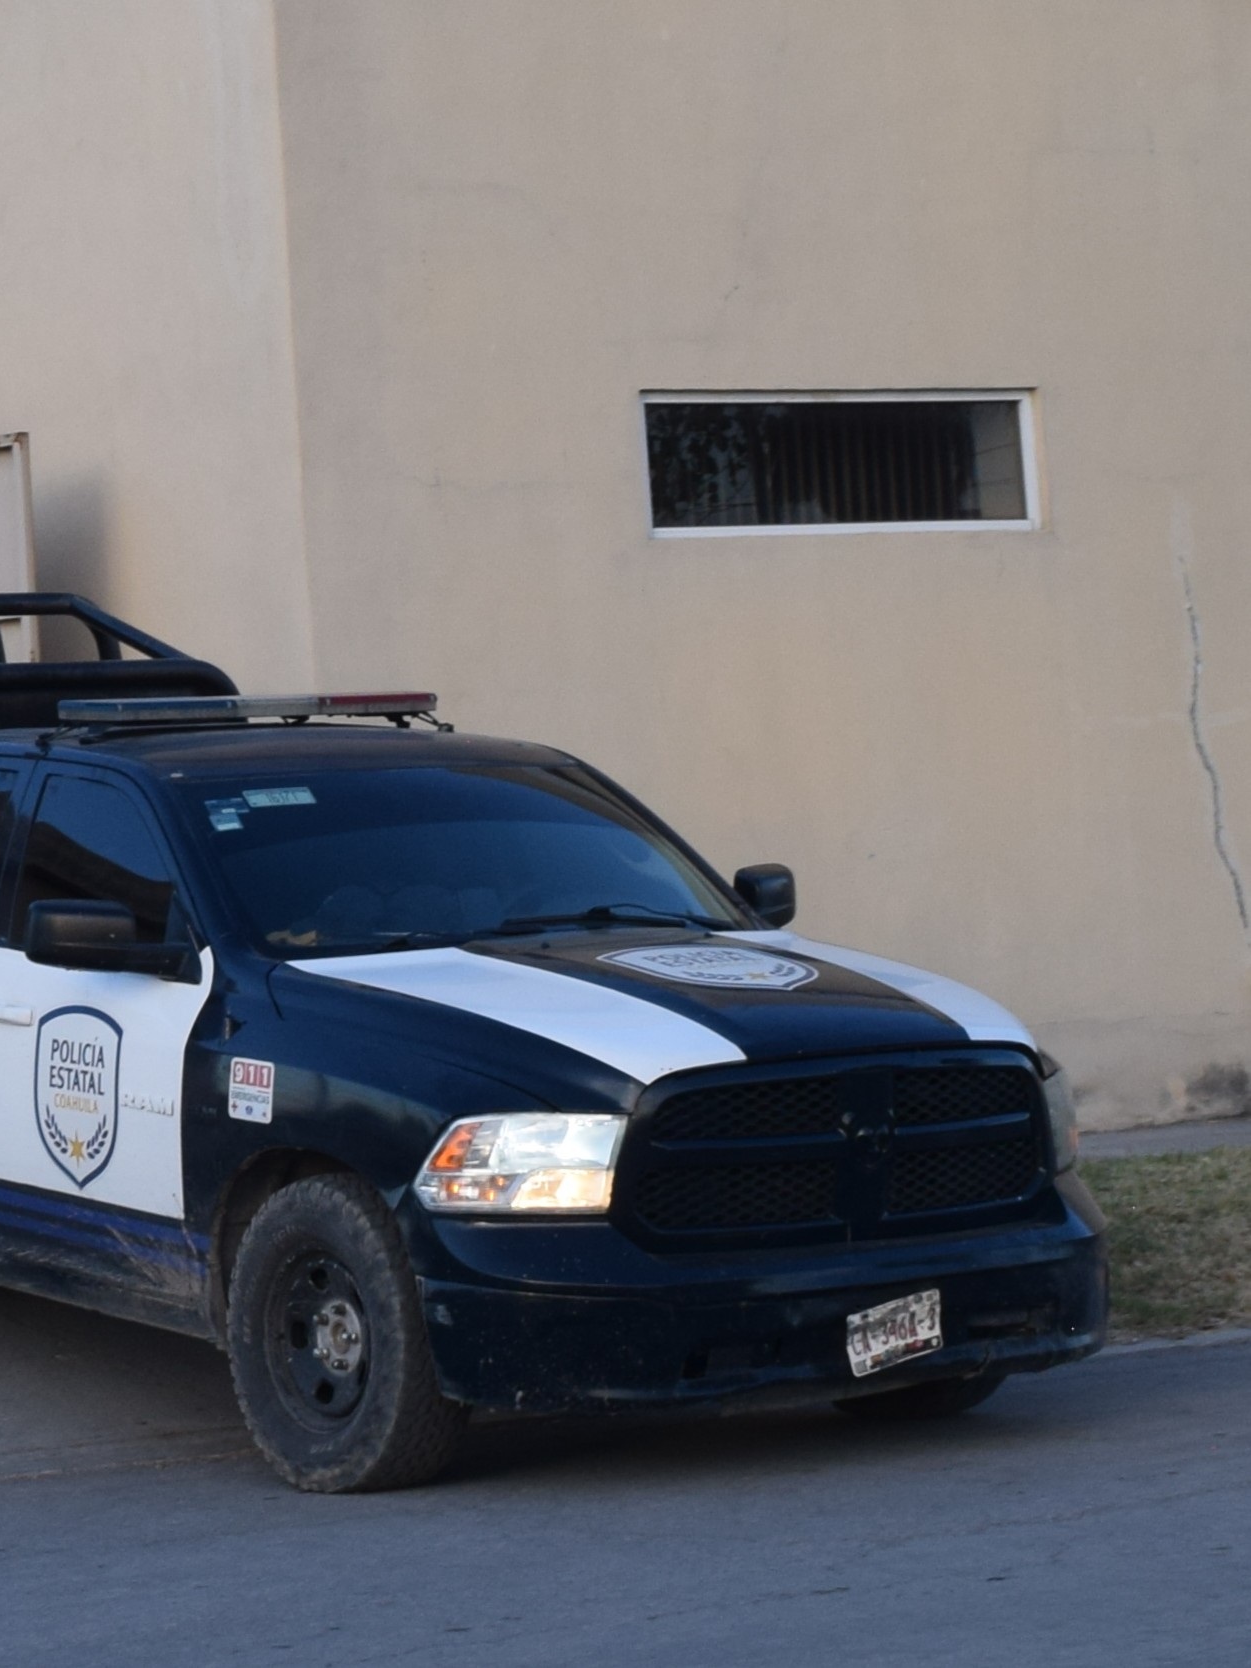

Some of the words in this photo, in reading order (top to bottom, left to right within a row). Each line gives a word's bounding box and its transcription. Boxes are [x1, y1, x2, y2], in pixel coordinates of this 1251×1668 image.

[50, 1037, 105, 1069] POLICÍA
[49, 1066, 105, 1096] ESTATAL
[234, 1063, 268, 1086] 911
[54, 1093, 98, 1114] COAHUILA
